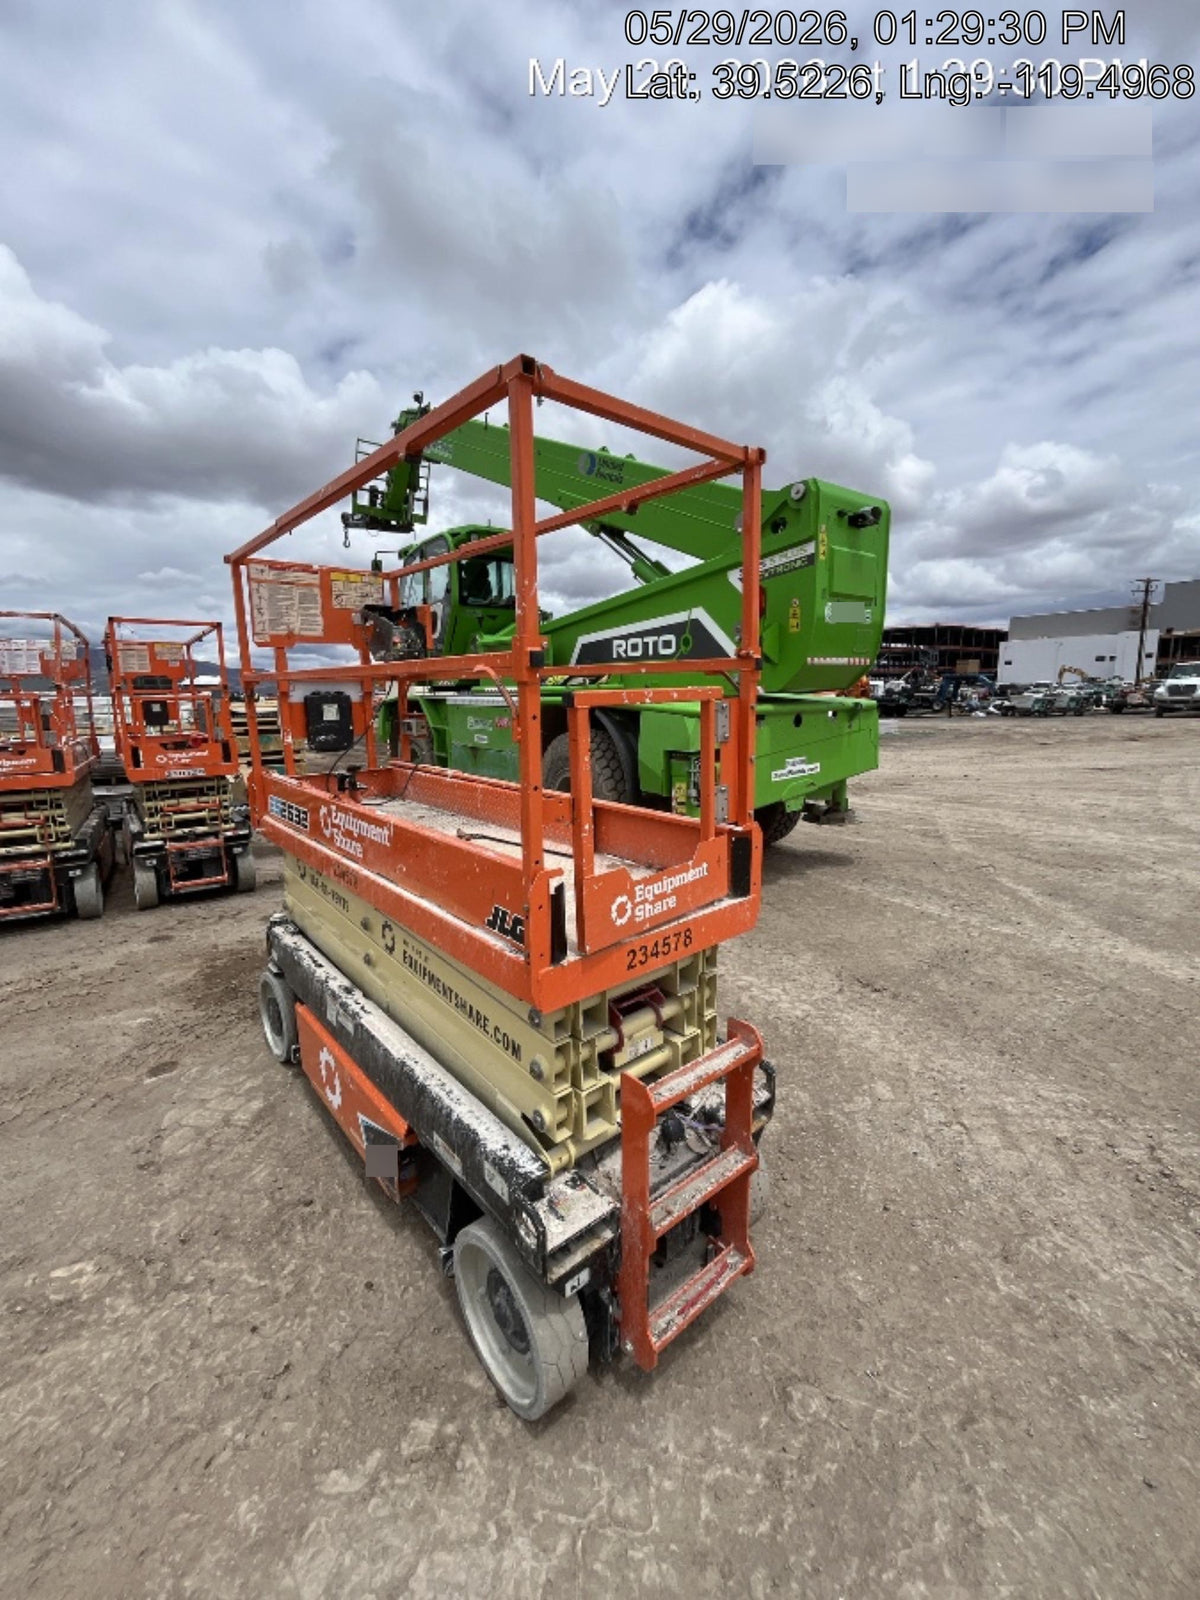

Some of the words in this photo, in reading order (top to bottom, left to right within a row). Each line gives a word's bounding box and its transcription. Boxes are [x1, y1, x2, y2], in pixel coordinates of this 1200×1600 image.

[612, 634, 677, 659] ROTO
[330, 804, 391, 847] Equipment
[333, 828, 364, 859] Share
[634, 862, 708, 903] Equipment
[485, 904, 526, 947] JLG
[634, 896, 677, 923] Share
[626, 927, 693, 971] 234578
[402, 949, 523, 1062] EQUIPMENTSHARE.COM
